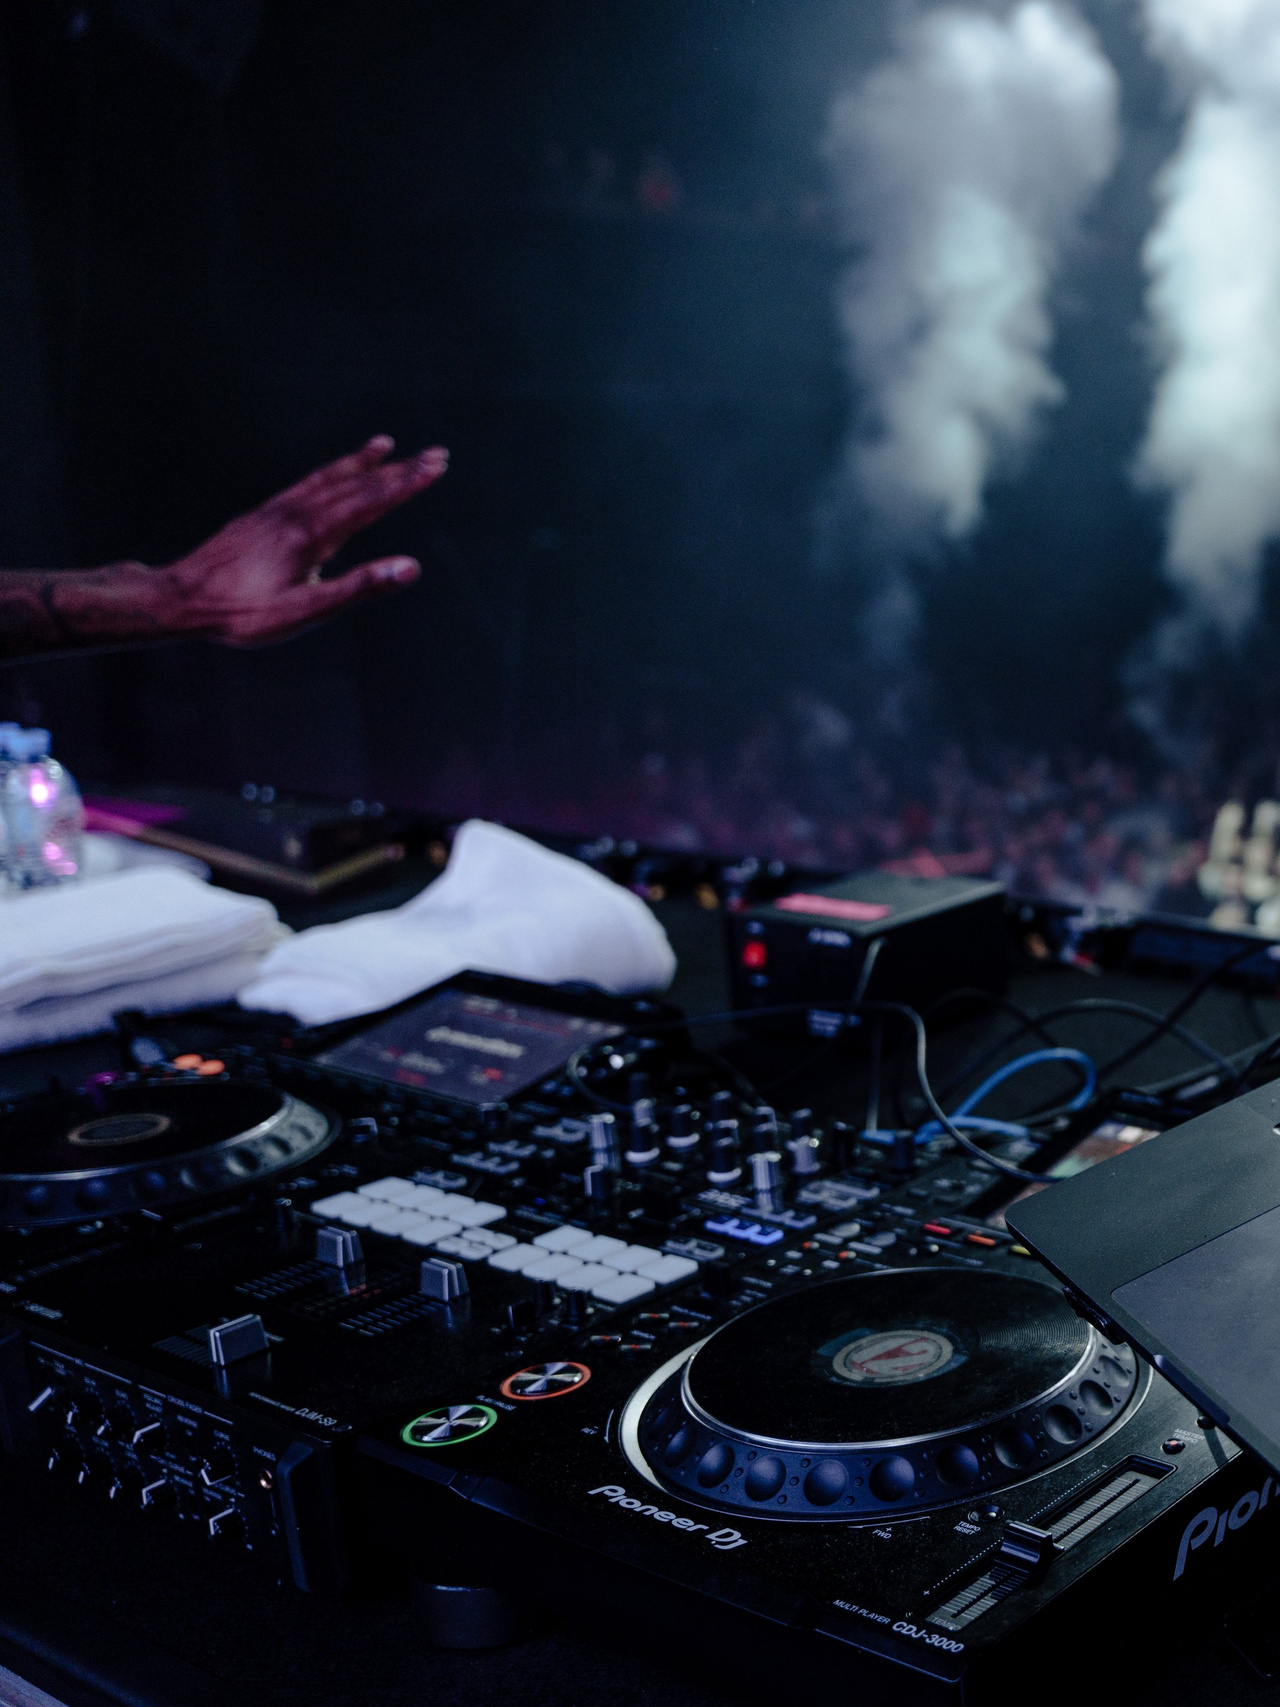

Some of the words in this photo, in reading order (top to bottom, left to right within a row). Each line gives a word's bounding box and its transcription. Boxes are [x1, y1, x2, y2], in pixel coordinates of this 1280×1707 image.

[587, 1484, 710, 1532] Pioneer
[705, 1527, 749, 1550] DJ
[872, 1529, 892, 1539] FWD
[832, 1599, 860, 1613] MULTI
[857, 1608, 891, 1625] PLAYER
[892, 1621, 965, 1653] CDJ-3000
